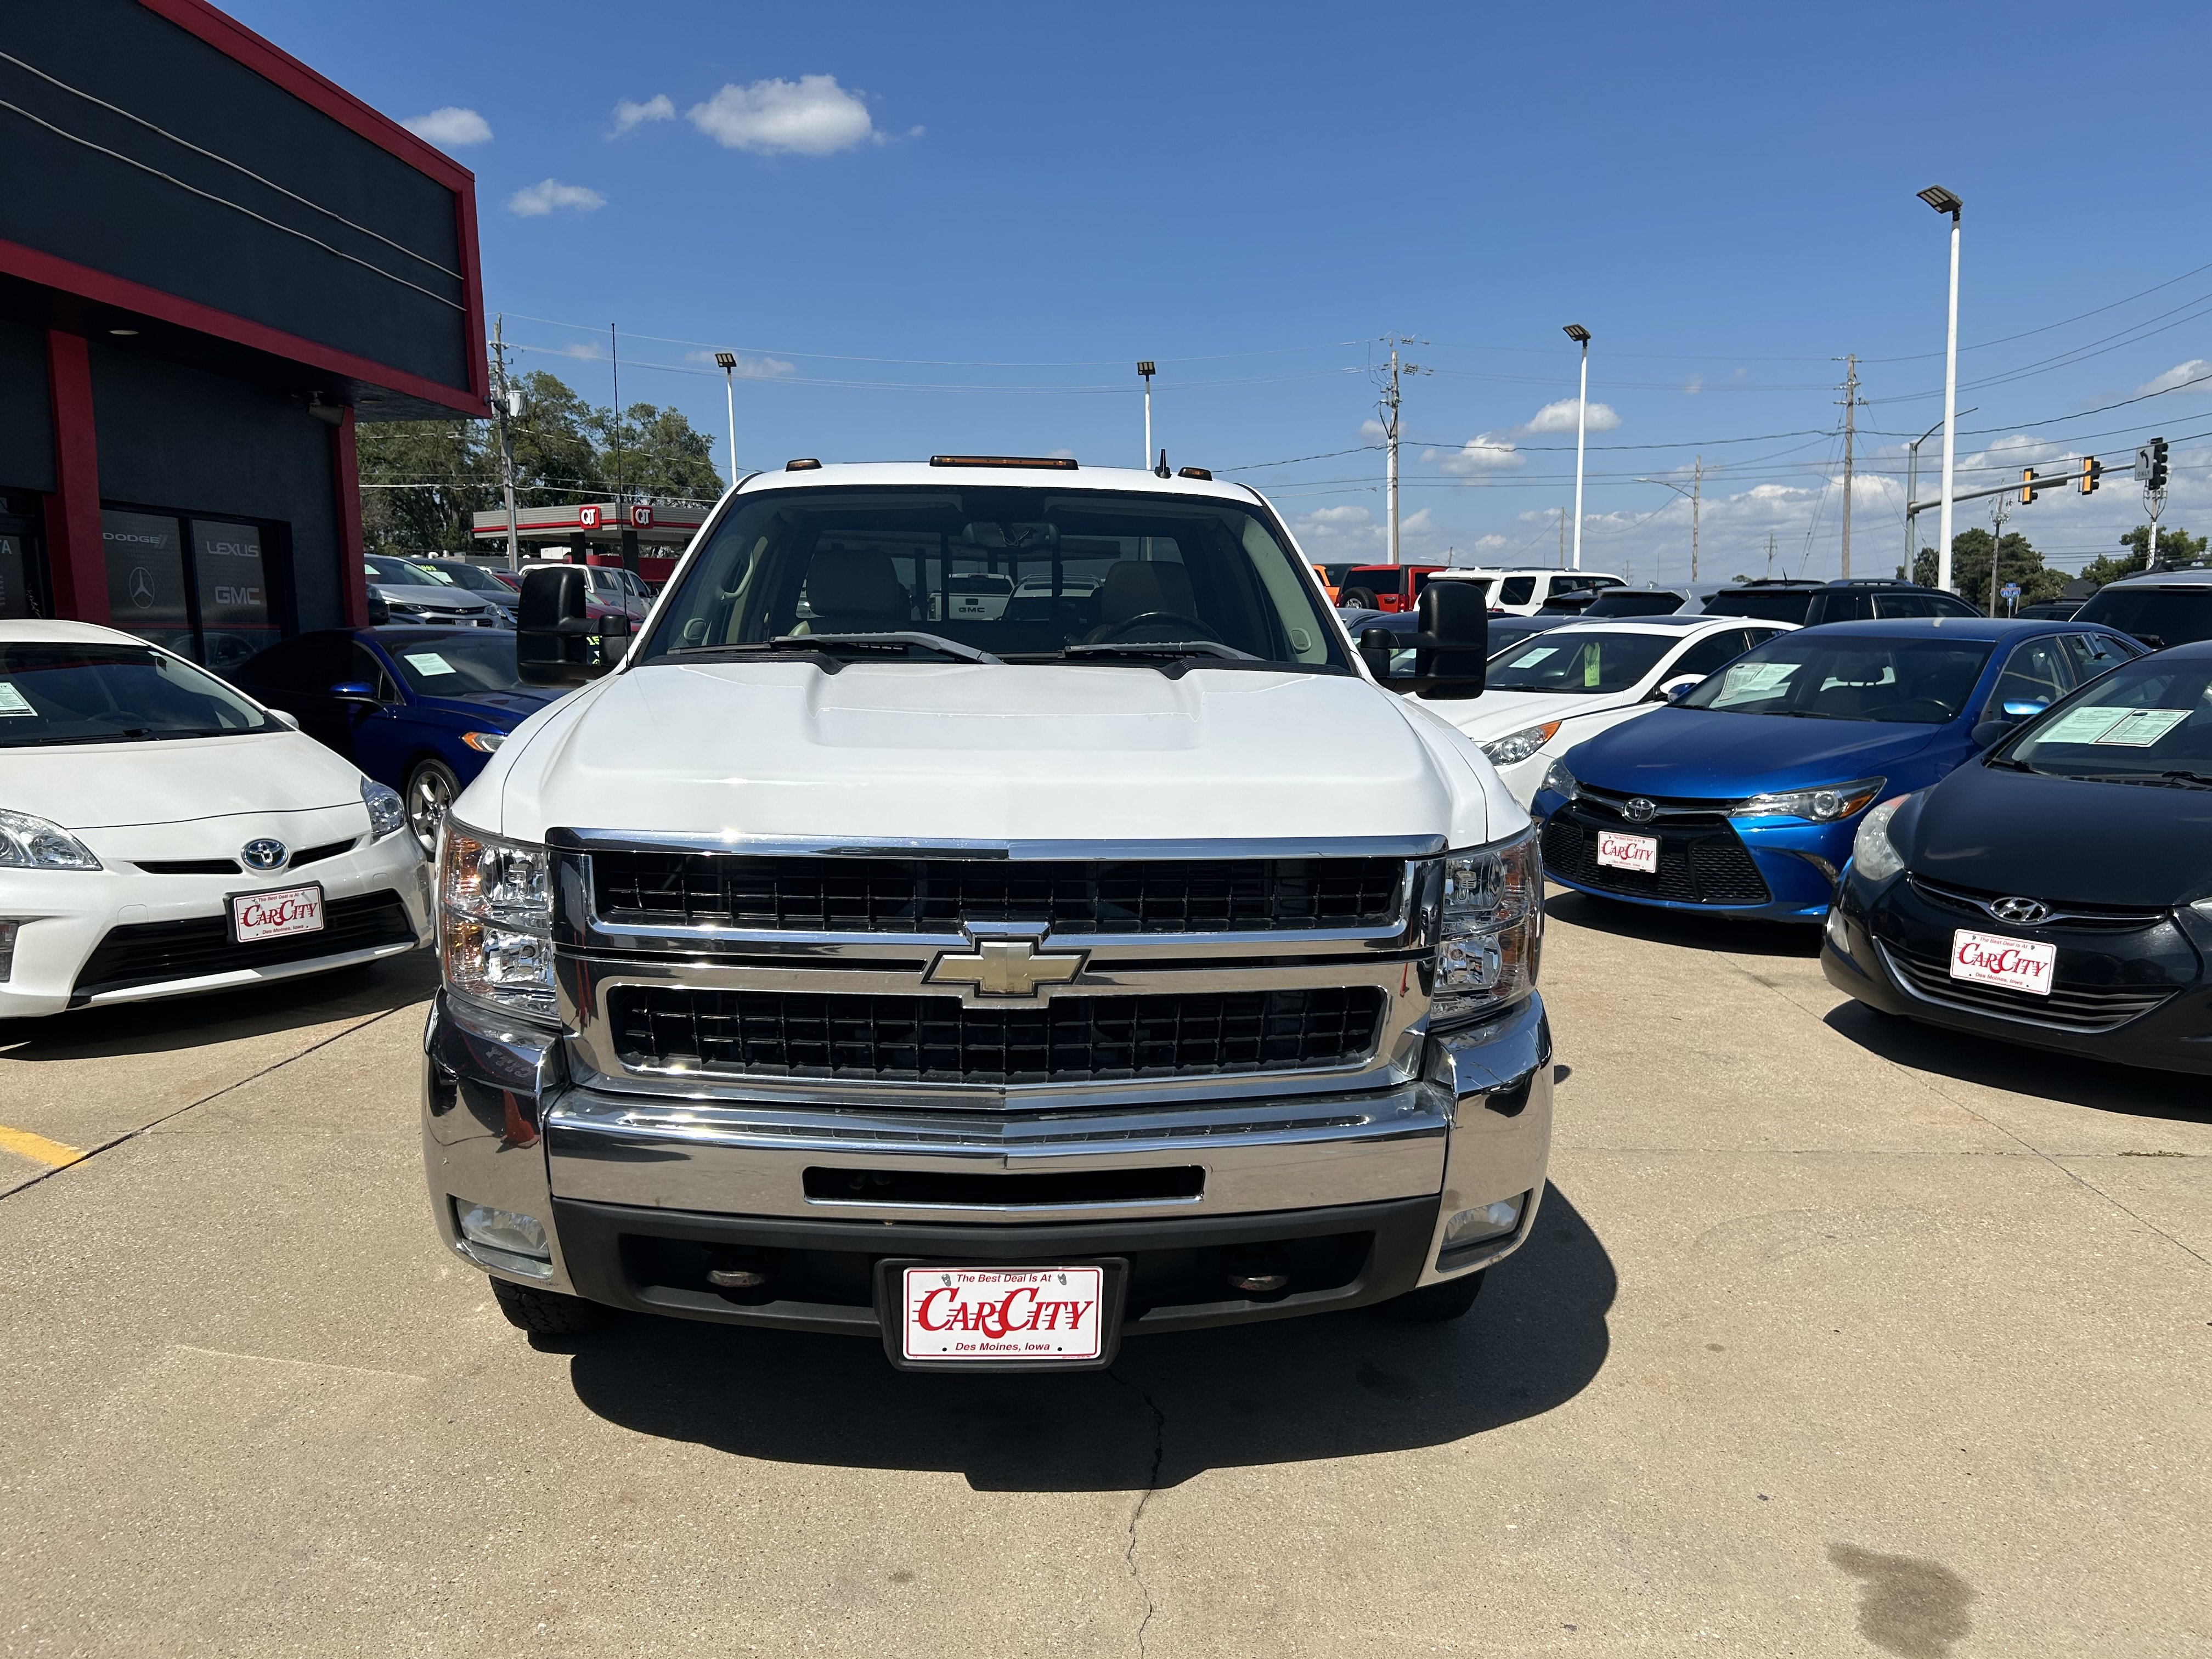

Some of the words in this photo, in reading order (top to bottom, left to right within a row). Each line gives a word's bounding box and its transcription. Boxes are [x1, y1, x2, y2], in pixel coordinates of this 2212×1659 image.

[581, 509, 596, 526] QT
[635, 508, 650, 525] QT
[103, 533, 161, 544] DODGE
[206, 541, 259, 557] LEXUS
[215, 586, 261, 605] GMC
[957, 1274, 975, 1282] The
[978, 1274, 1001, 1282] Best
[1004, 1273, 1026, 1282] Deal
[1040, 1274, 1052, 1282] At
[955, 1342, 976, 1351] Des
[979, 1342, 1021, 1352] Moines,
[1025, 1342, 1050, 1351] Iowa
